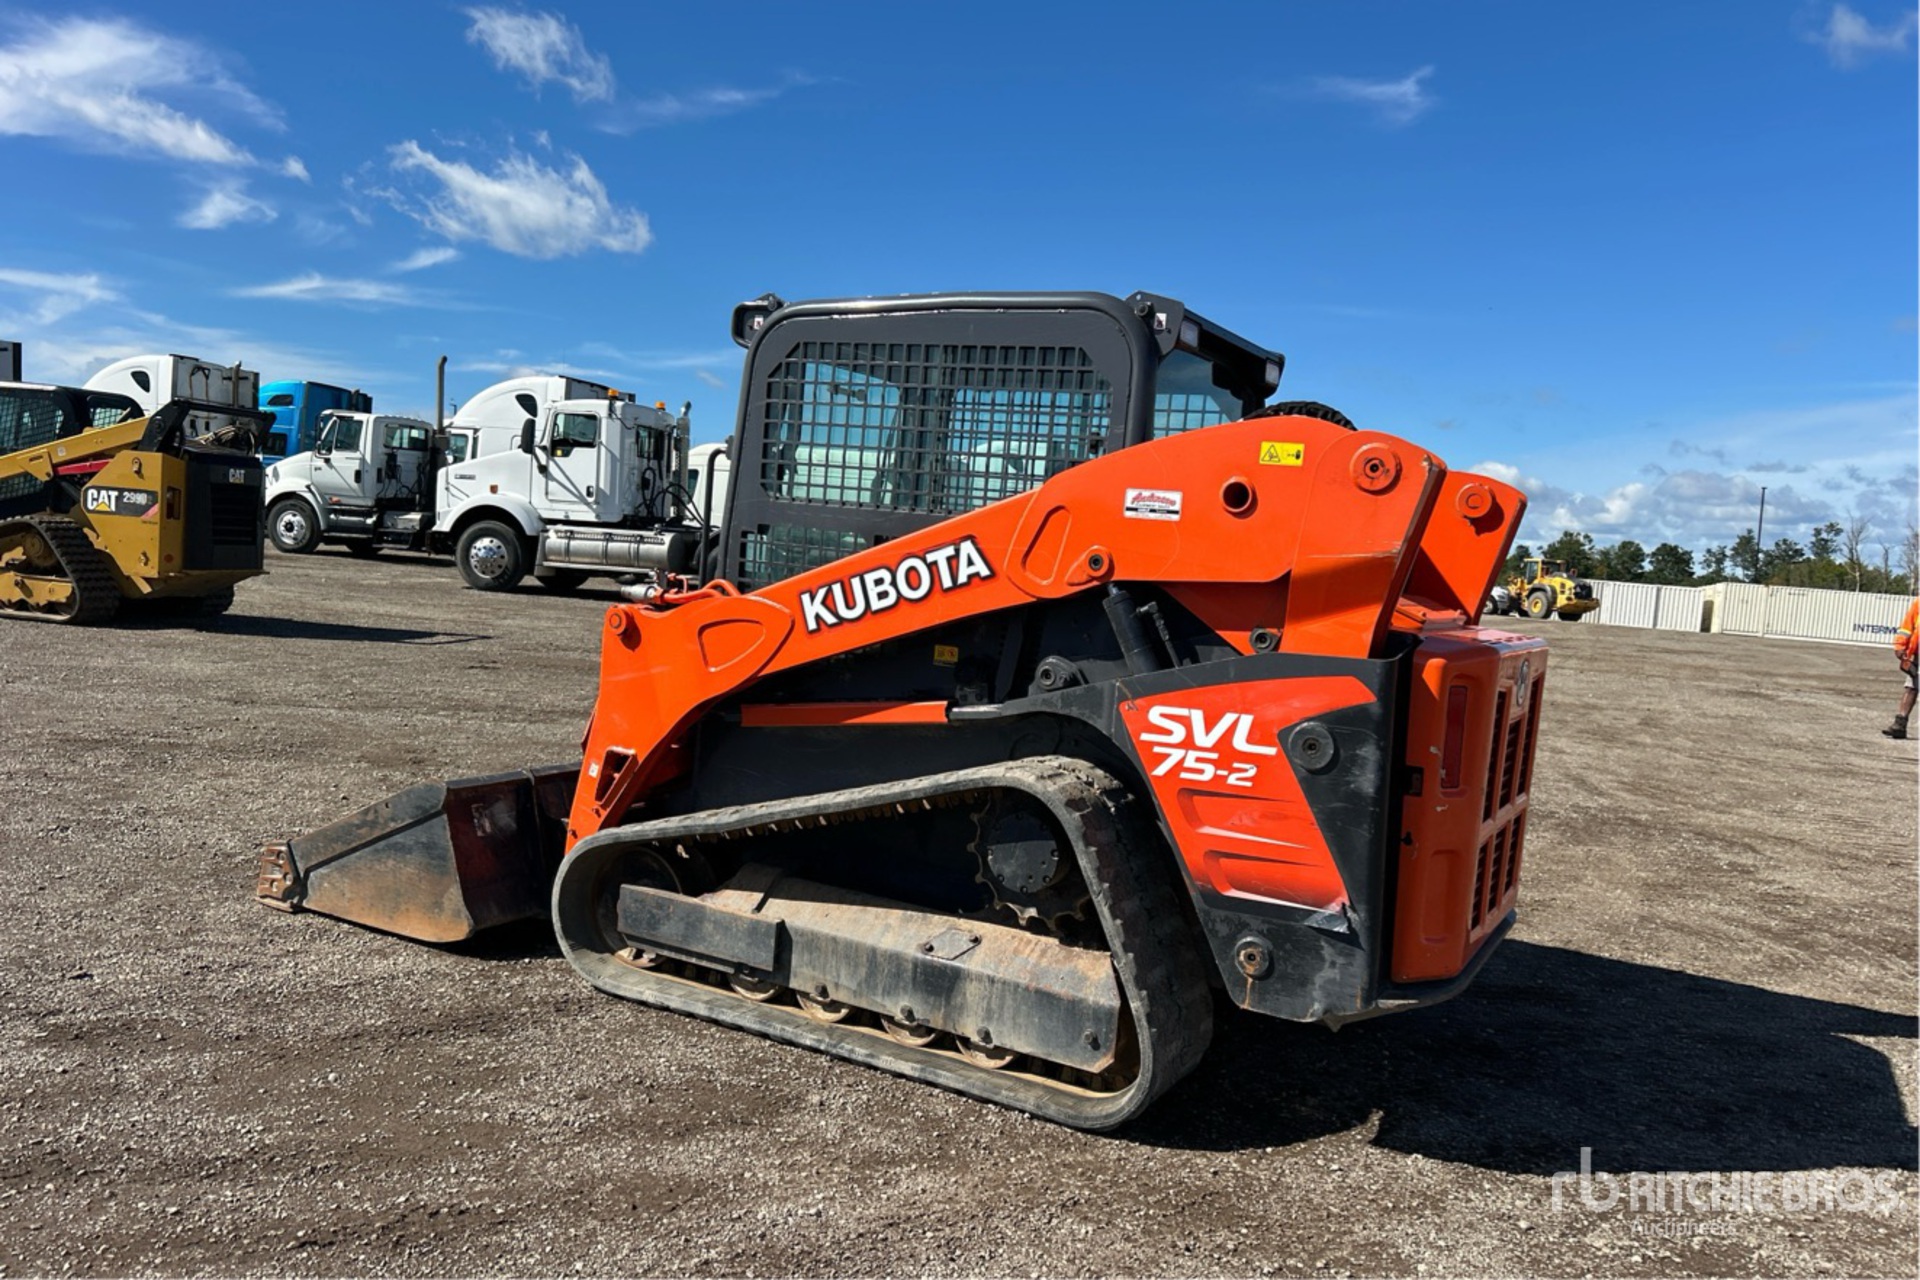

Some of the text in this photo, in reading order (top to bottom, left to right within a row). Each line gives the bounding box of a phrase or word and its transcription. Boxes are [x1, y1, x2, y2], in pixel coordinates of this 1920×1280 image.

[229, 468, 246, 484] CAT
[86, 488, 119, 512] CAT
[800, 539, 992, 632] KUBOTA
[1139, 705, 1278, 756] SVL
[1150, 746, 1258, 787] 75-2
